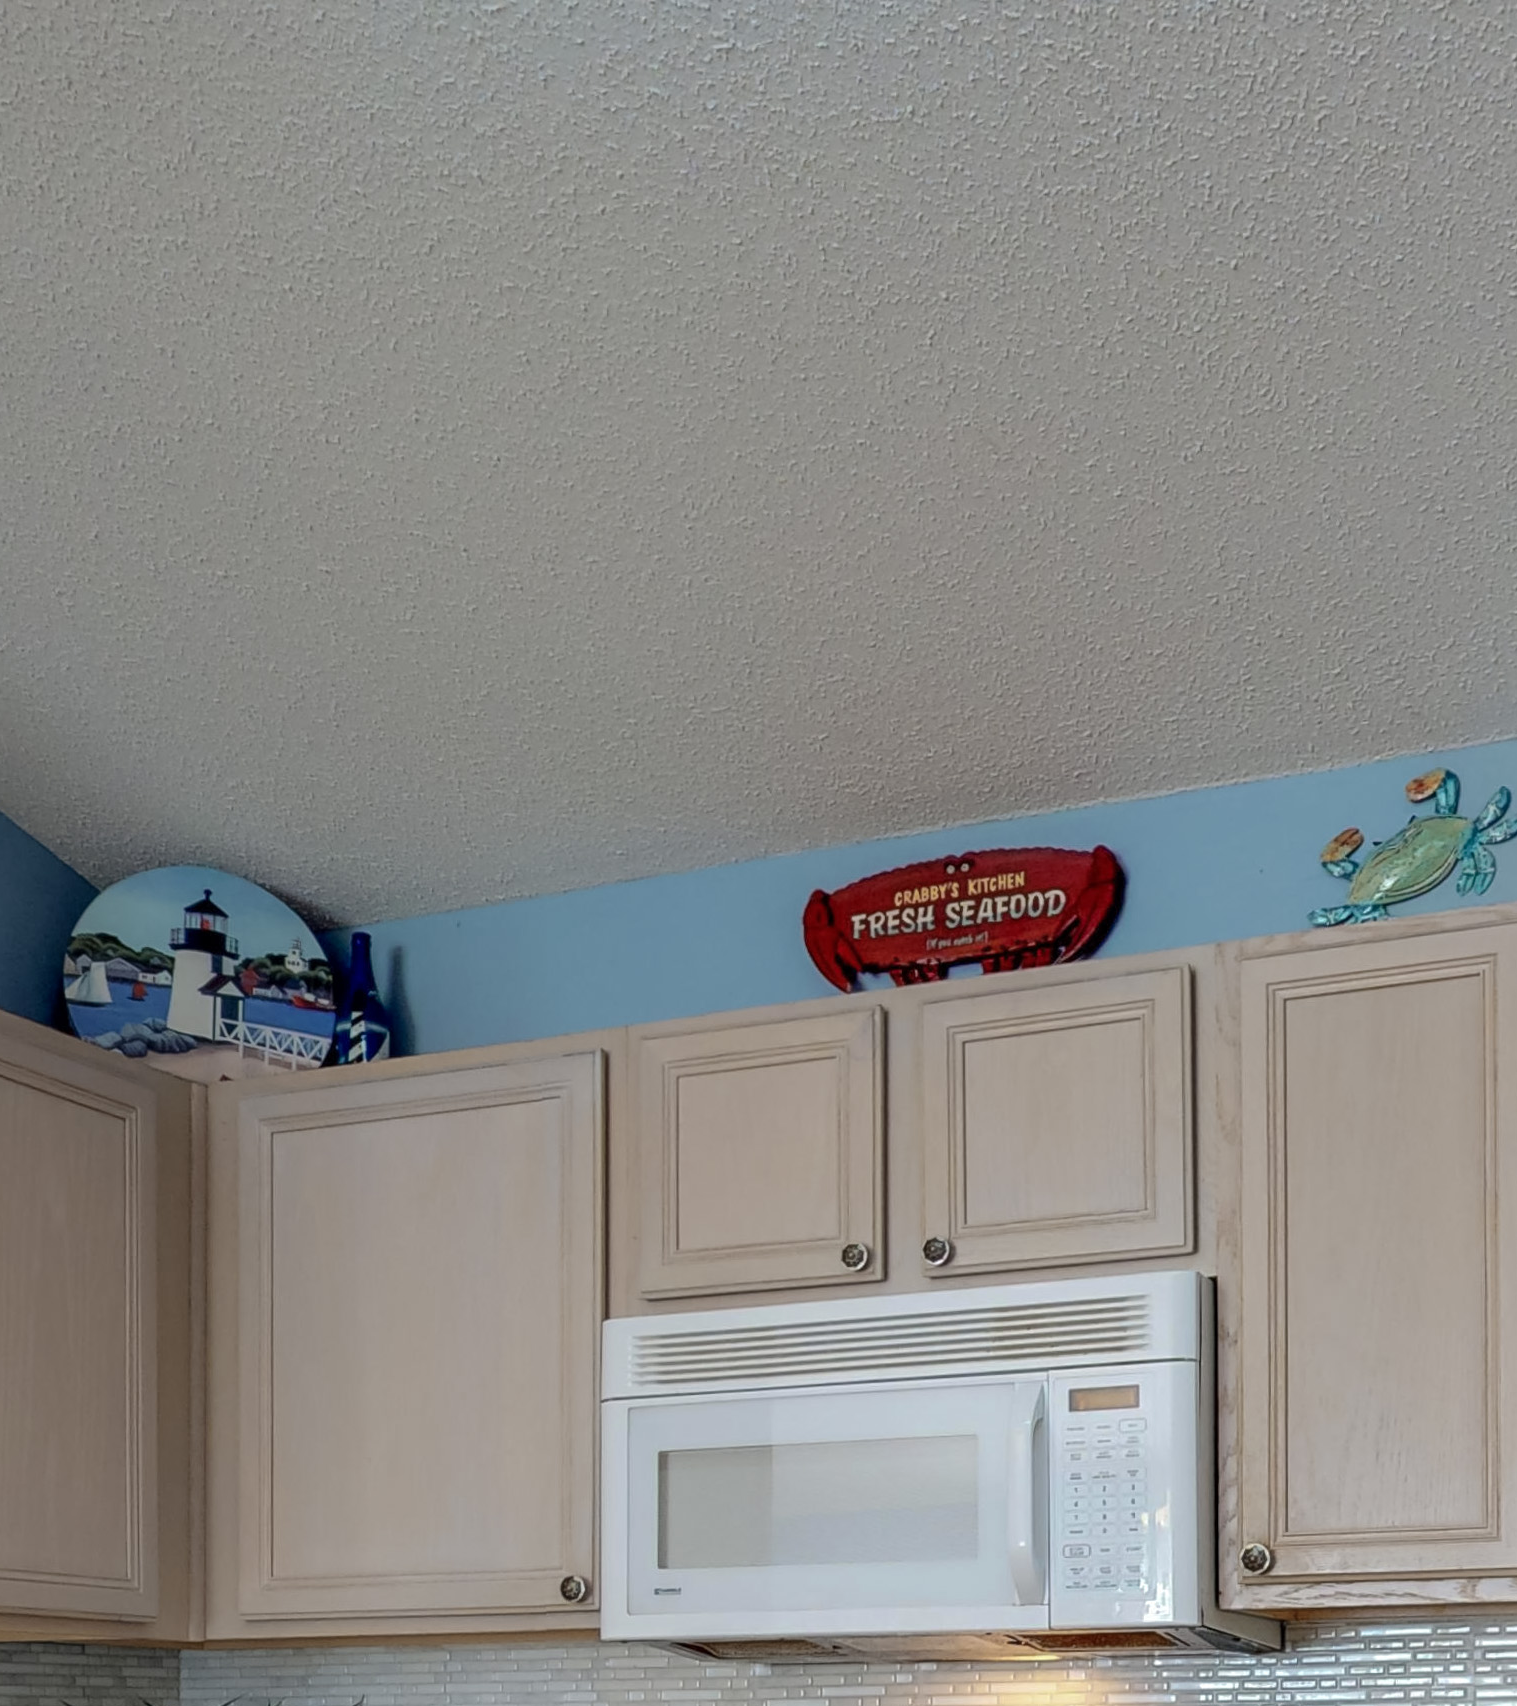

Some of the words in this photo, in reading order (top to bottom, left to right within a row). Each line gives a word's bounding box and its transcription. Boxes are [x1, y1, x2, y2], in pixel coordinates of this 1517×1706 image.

[894, 882, 959, 907] CRABBY'S
[968, 871, 1026, 896] KITCHEN
[851, 904, 936, 940] FRESH
[945, 888, 1067, 929] SEAFOOD
